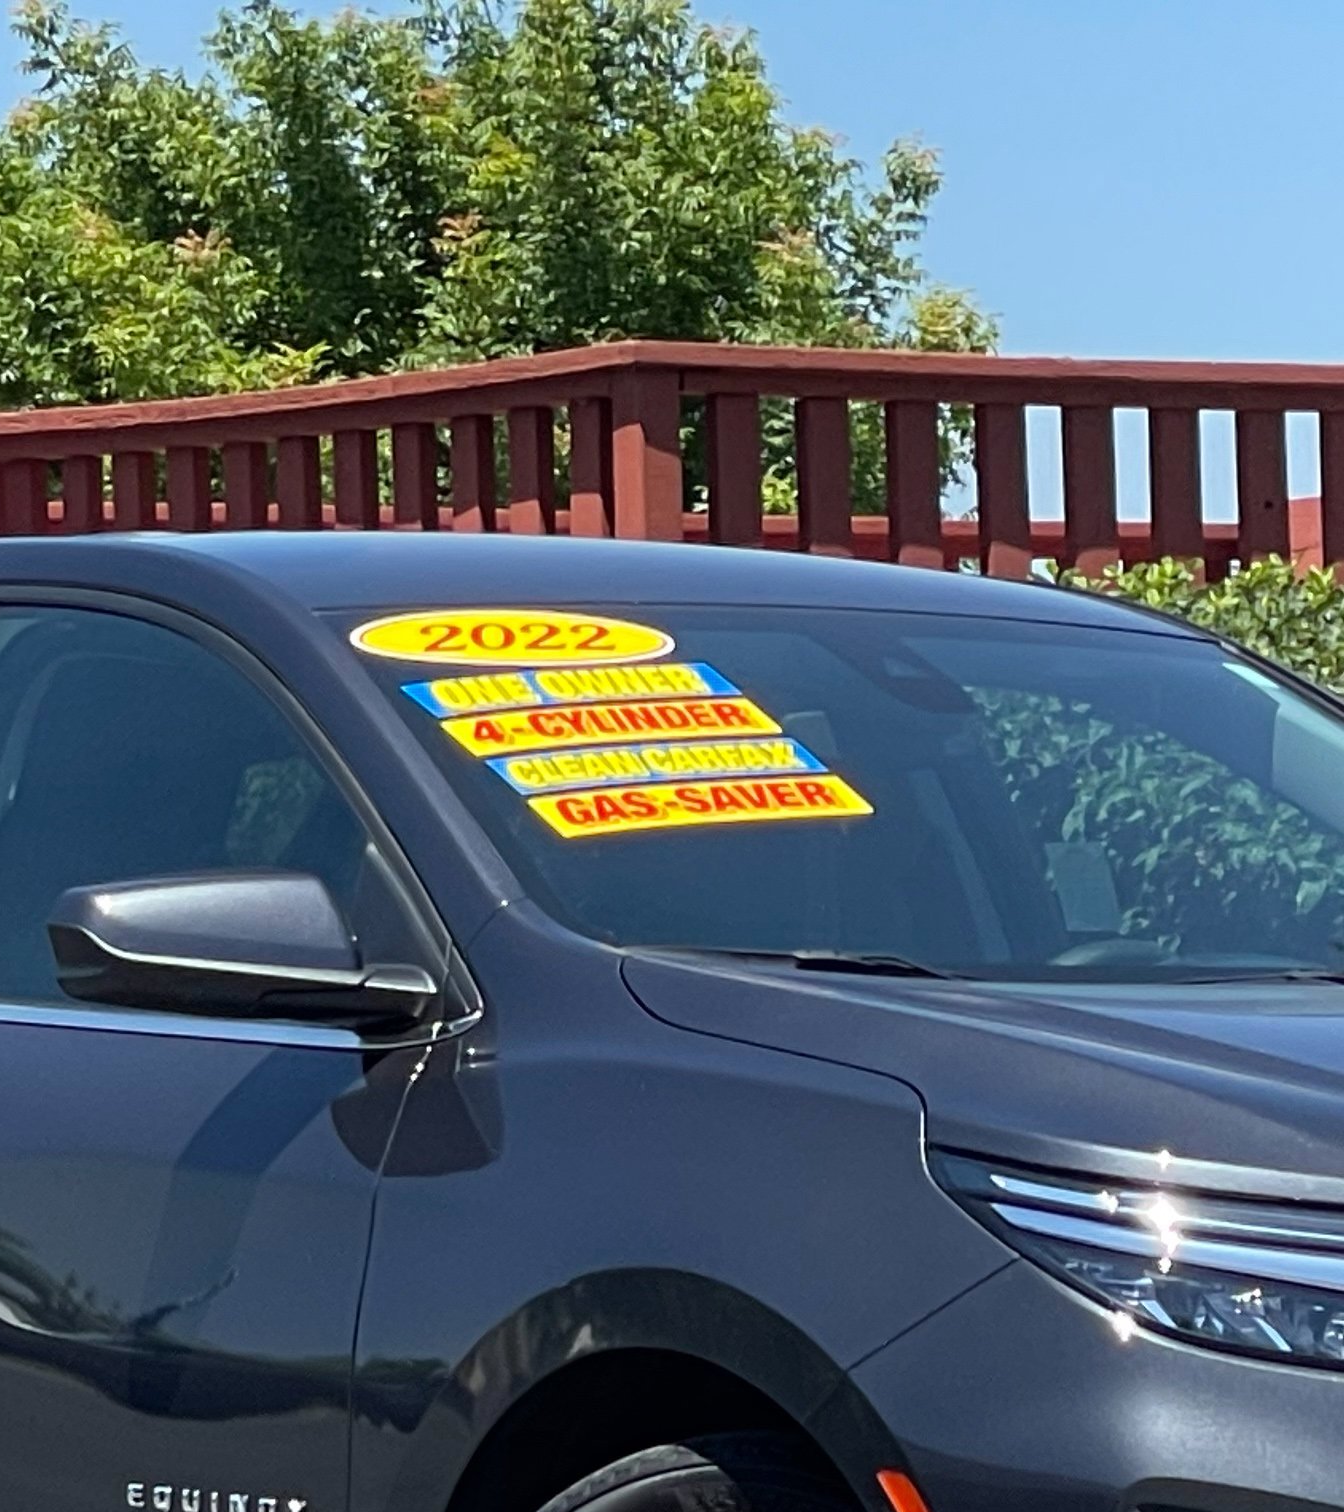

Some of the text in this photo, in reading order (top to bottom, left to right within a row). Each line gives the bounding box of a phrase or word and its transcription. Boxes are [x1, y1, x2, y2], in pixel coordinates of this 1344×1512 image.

[419, 622, 616, 652] 2022
[430, 664, 702, 711] ONE OWNER
[473, 702, 749, 744] 4-CYLINDER
[506, 750, 648, 787] CLEAN
[555, 780, 835, 826] GAS-SAVER
